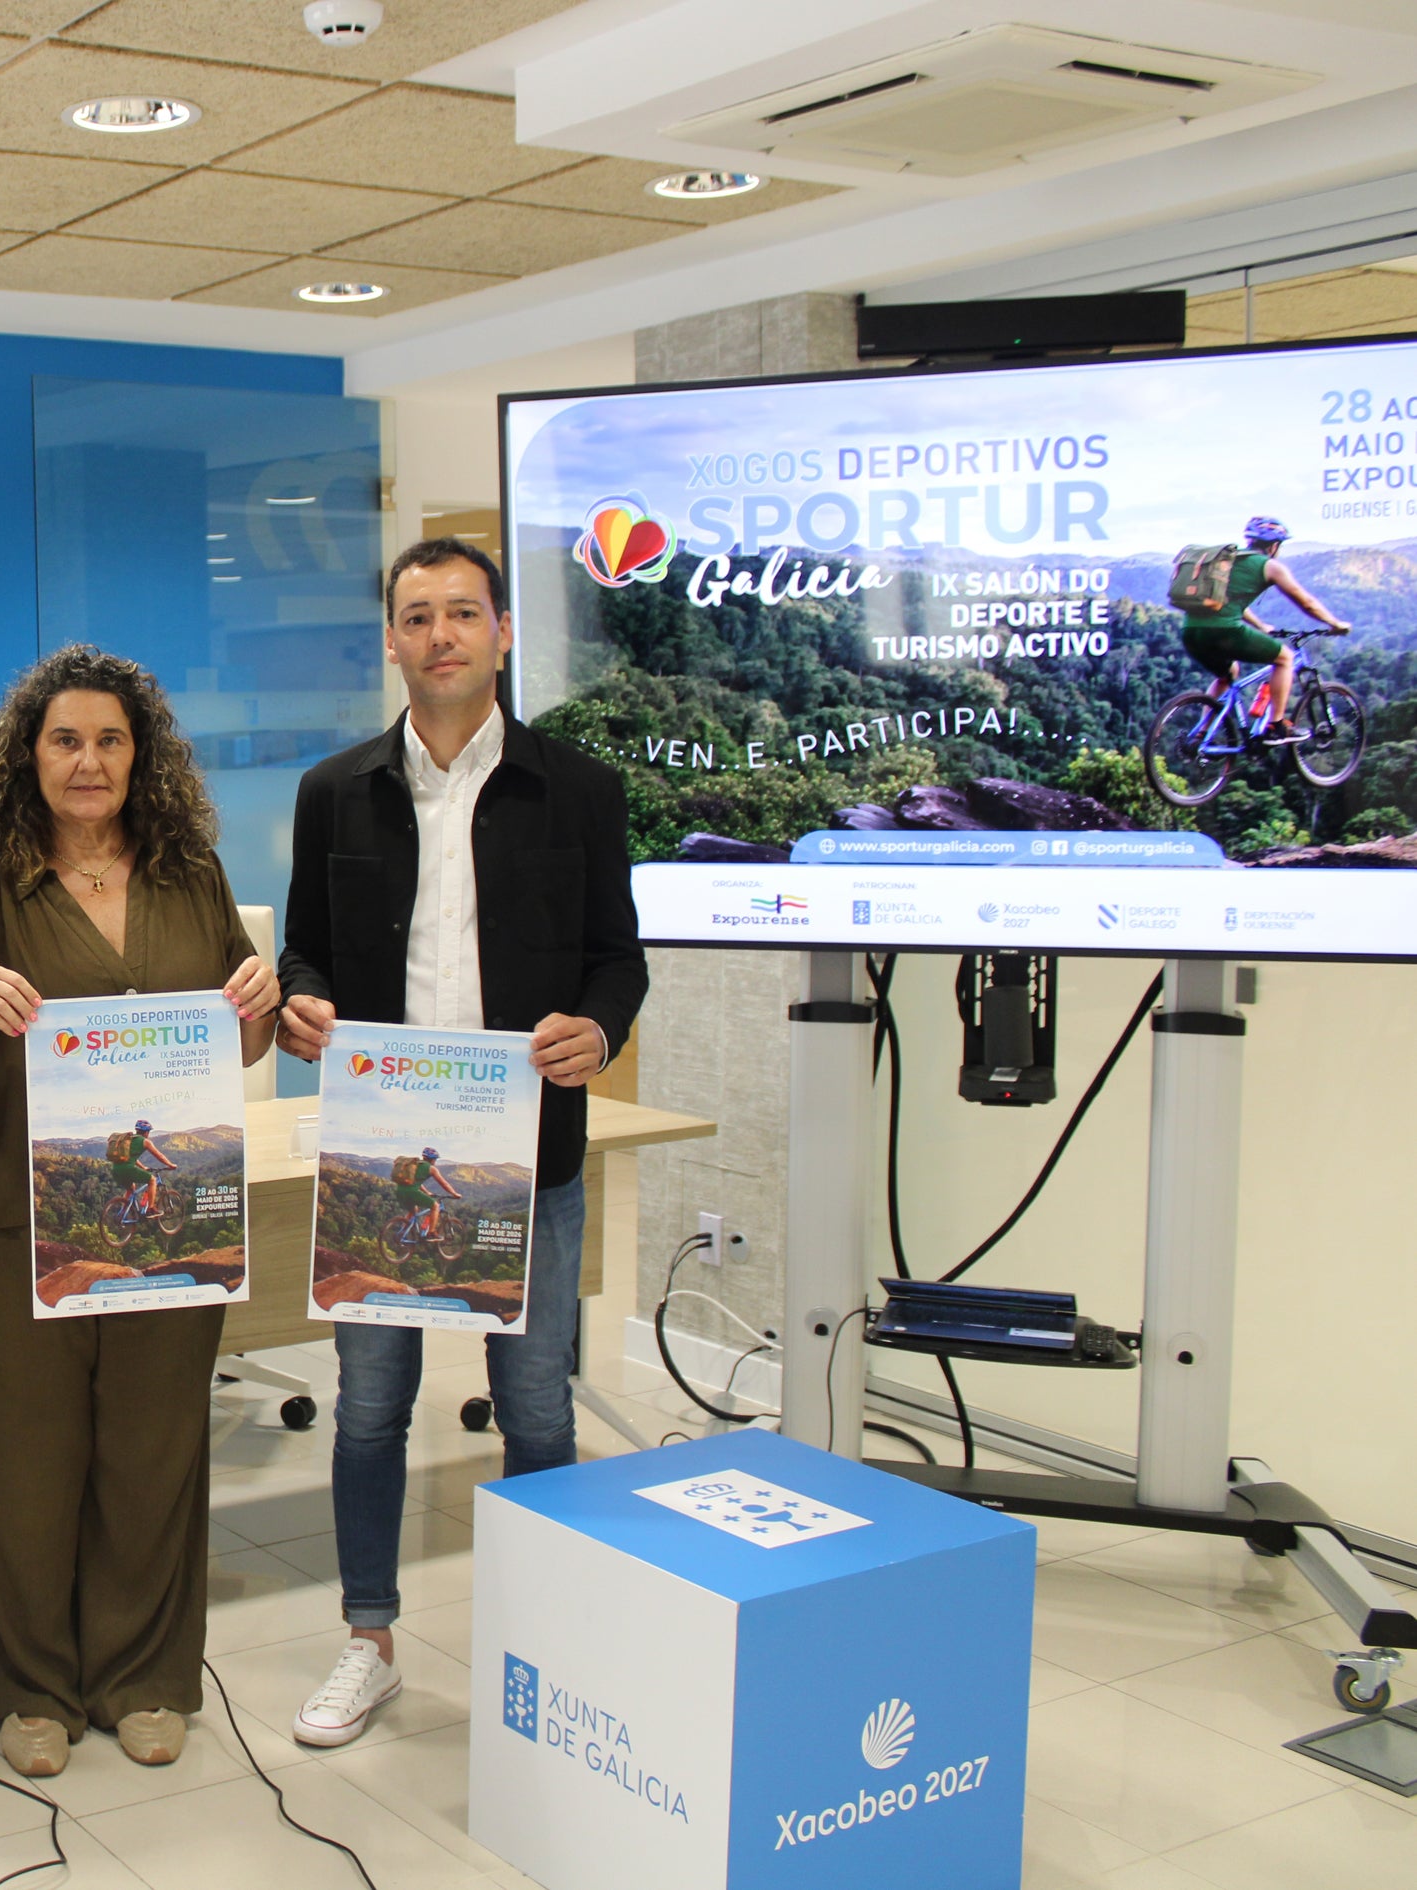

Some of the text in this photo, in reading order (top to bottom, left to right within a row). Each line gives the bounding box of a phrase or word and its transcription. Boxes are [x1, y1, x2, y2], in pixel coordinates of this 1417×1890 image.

[1321, 389, 1372, 425] 28
[1325, 432, 1404, 458] MAIO
[686, 434, 1109, 488] XOGOS DEPORTIVOS
[685, 480, 1110, 556] SPORTUR
[1322, 501, 1391, 520] OURENSE
[686, 546, 893, 608] Galicia
[932, 563, 1110, 597] IX SALÓN DO
[951, 600, 1109, 628] DEPORTE E
[872, 631, 1109, 661] TURISMO ACTIVO
[839, 840, 1016, 855] www.sporturgalicia.com
[1073, 841, 1195, 857] @sporturgalicia
[875, 902, 917, 913] XUNTA
[1002, 904, 1060, 917] Xacobeo
[1129, 906, 1181, 918] DEPORTE
[712, 913, 811, 927] Expourense
[874, 914, 943, 926] DE GALICIA
[1003, 918, 1031, 929] 2027
[1129, 919, 1177, 930] GALEGO
[86, 1008, 208, 1026] XOGOS DEPORTIVOS
[86, 1024, 209, 1050] SPORTUR
[87, 1046, 150, 1066] Galicia
[198, 1048, 210, 1056] DO
[382, 1041, 508, 1059] XOGOS DEPORTIVOS
[166, 1058, 203, 1068] DEPORTE
[380, 1056, 507, 1083] SPORTUR
[144, 1068, 211, 1079] TURISMO ACTIVO
[380, 1073, 441, 1091] Galicia
[459, 1095, 497, 1104] DEPORTE
[494, 1087, 506, 1095] DO
[436, 1102, 505, 1114] TURISMO ACTIVO
[195, 1187, 206, 1196] 28
[217, 1185, 229, 1195] 30
[229, 1186, 238, 1194] DE
[547, 1681, 633, 1756] XUNTA
[545, 1716, 689, 1825] DE GALICIA
[774, 1755, 990, 1852] Xacobeo 2027
